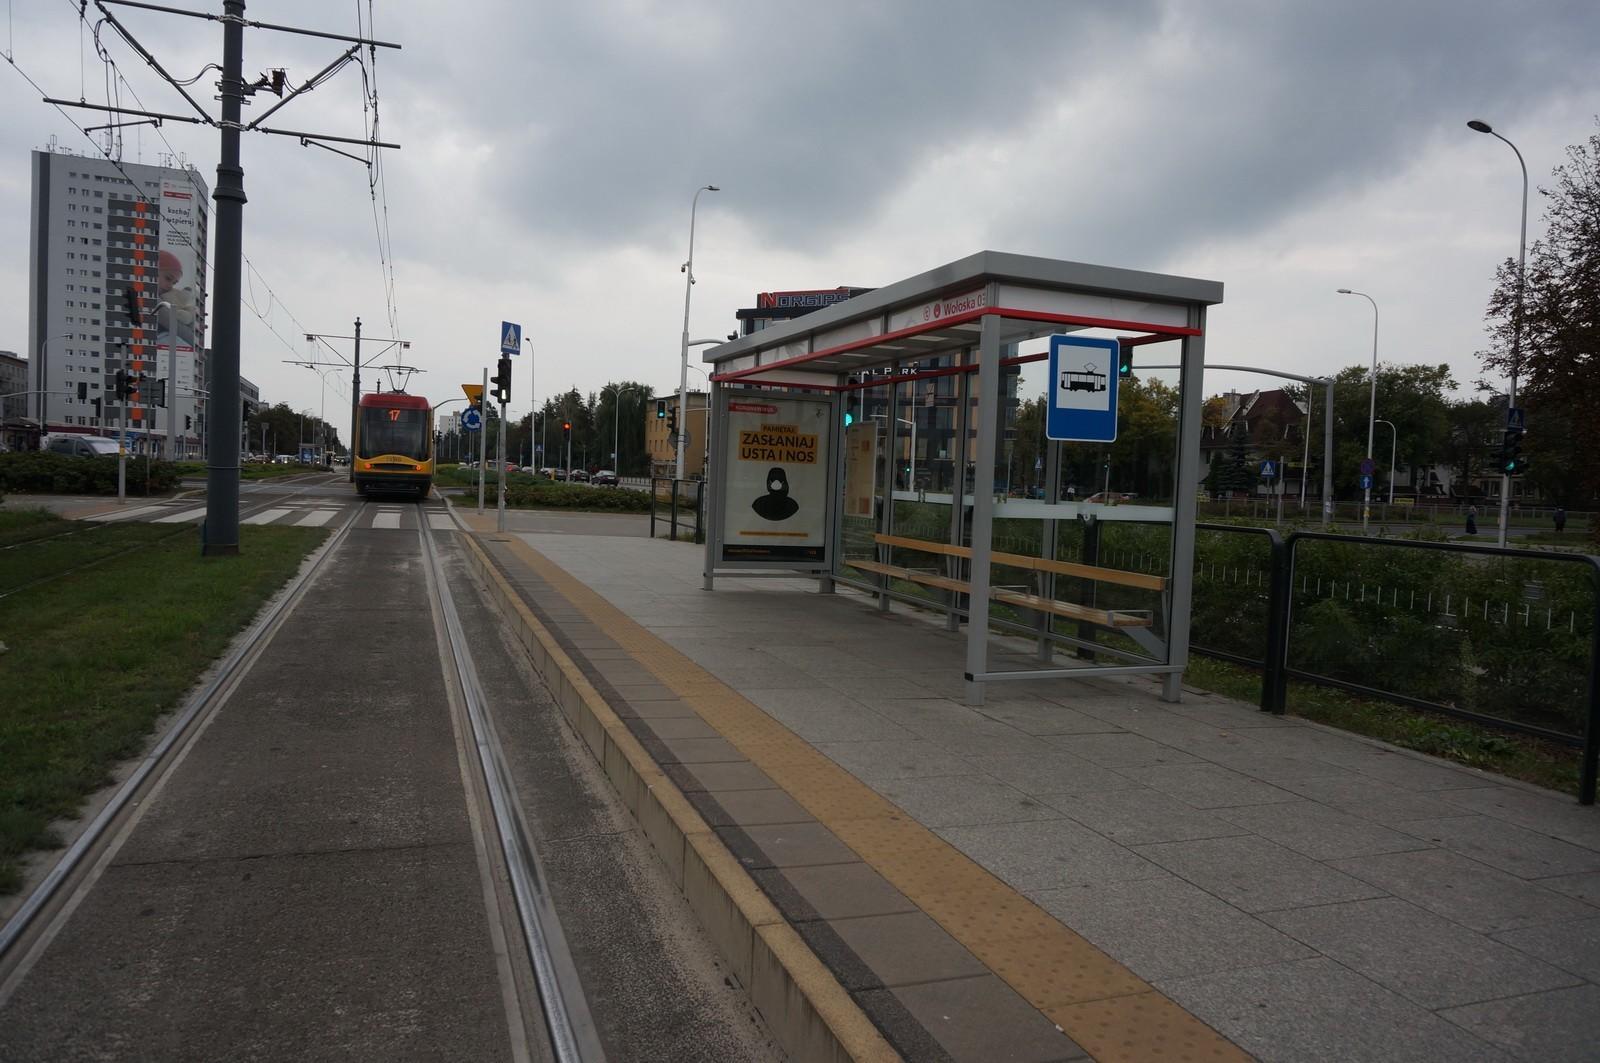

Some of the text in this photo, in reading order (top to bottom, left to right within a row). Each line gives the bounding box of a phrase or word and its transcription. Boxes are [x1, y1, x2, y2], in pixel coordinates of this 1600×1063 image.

[944, 297, 976, 316] Wołoska
[884, 367, 917, 375] PRK
[388, 409, 401, 421] 17
[742, 433, 814, 449] ZASŁANIAJ
[742, 448, 814, 463] USTA I NOS
